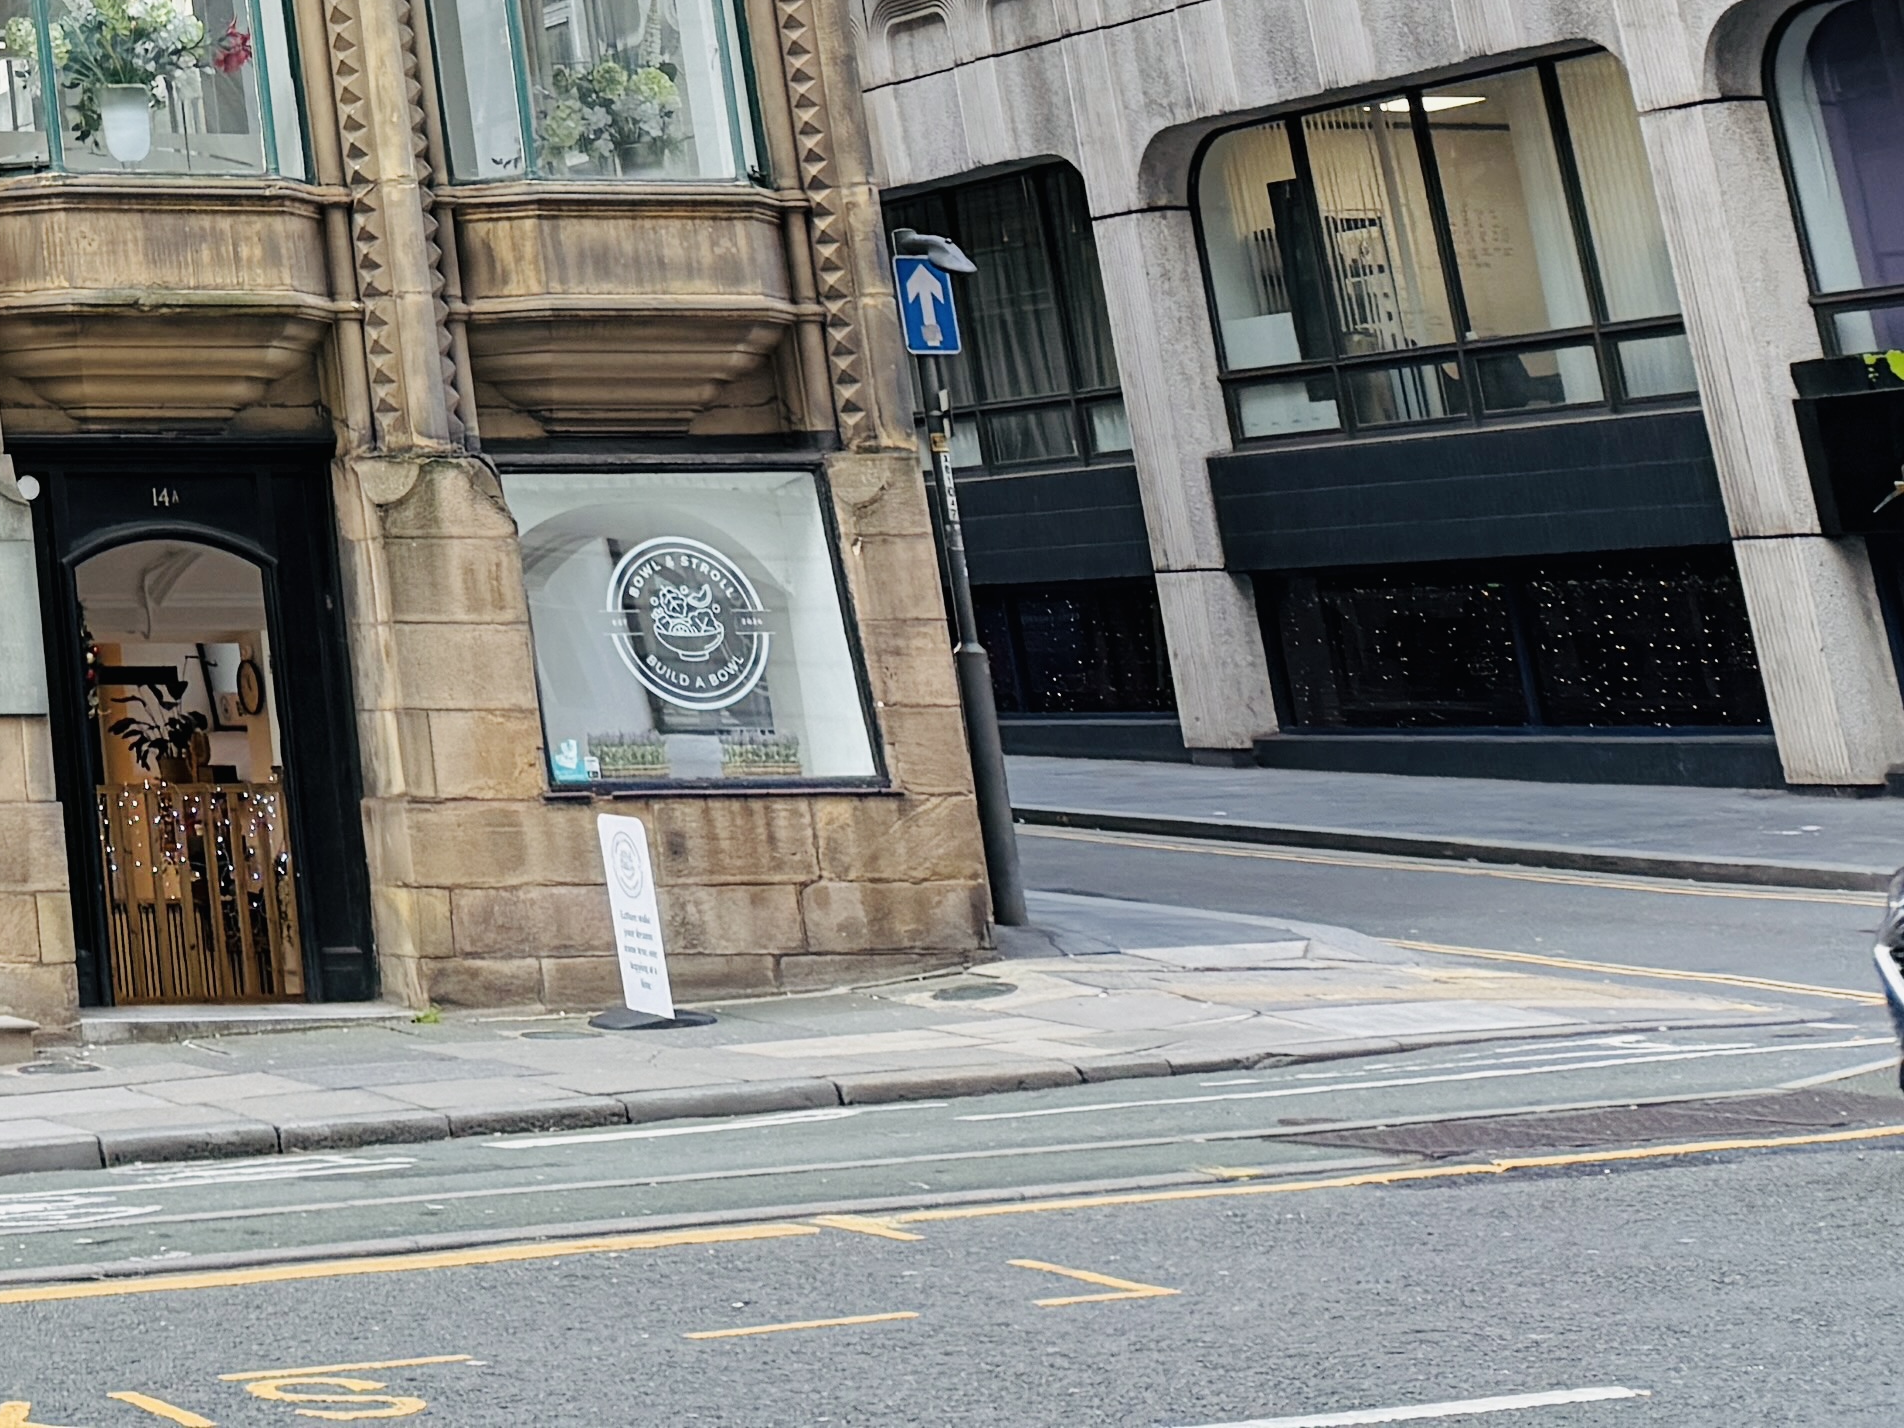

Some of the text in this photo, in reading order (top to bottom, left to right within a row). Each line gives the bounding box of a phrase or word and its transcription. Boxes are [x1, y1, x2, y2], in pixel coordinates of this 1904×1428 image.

[629, 555, 737, 599] BOWL & STROLL
[645, 654, 745, 689] BUILD A BOWL
